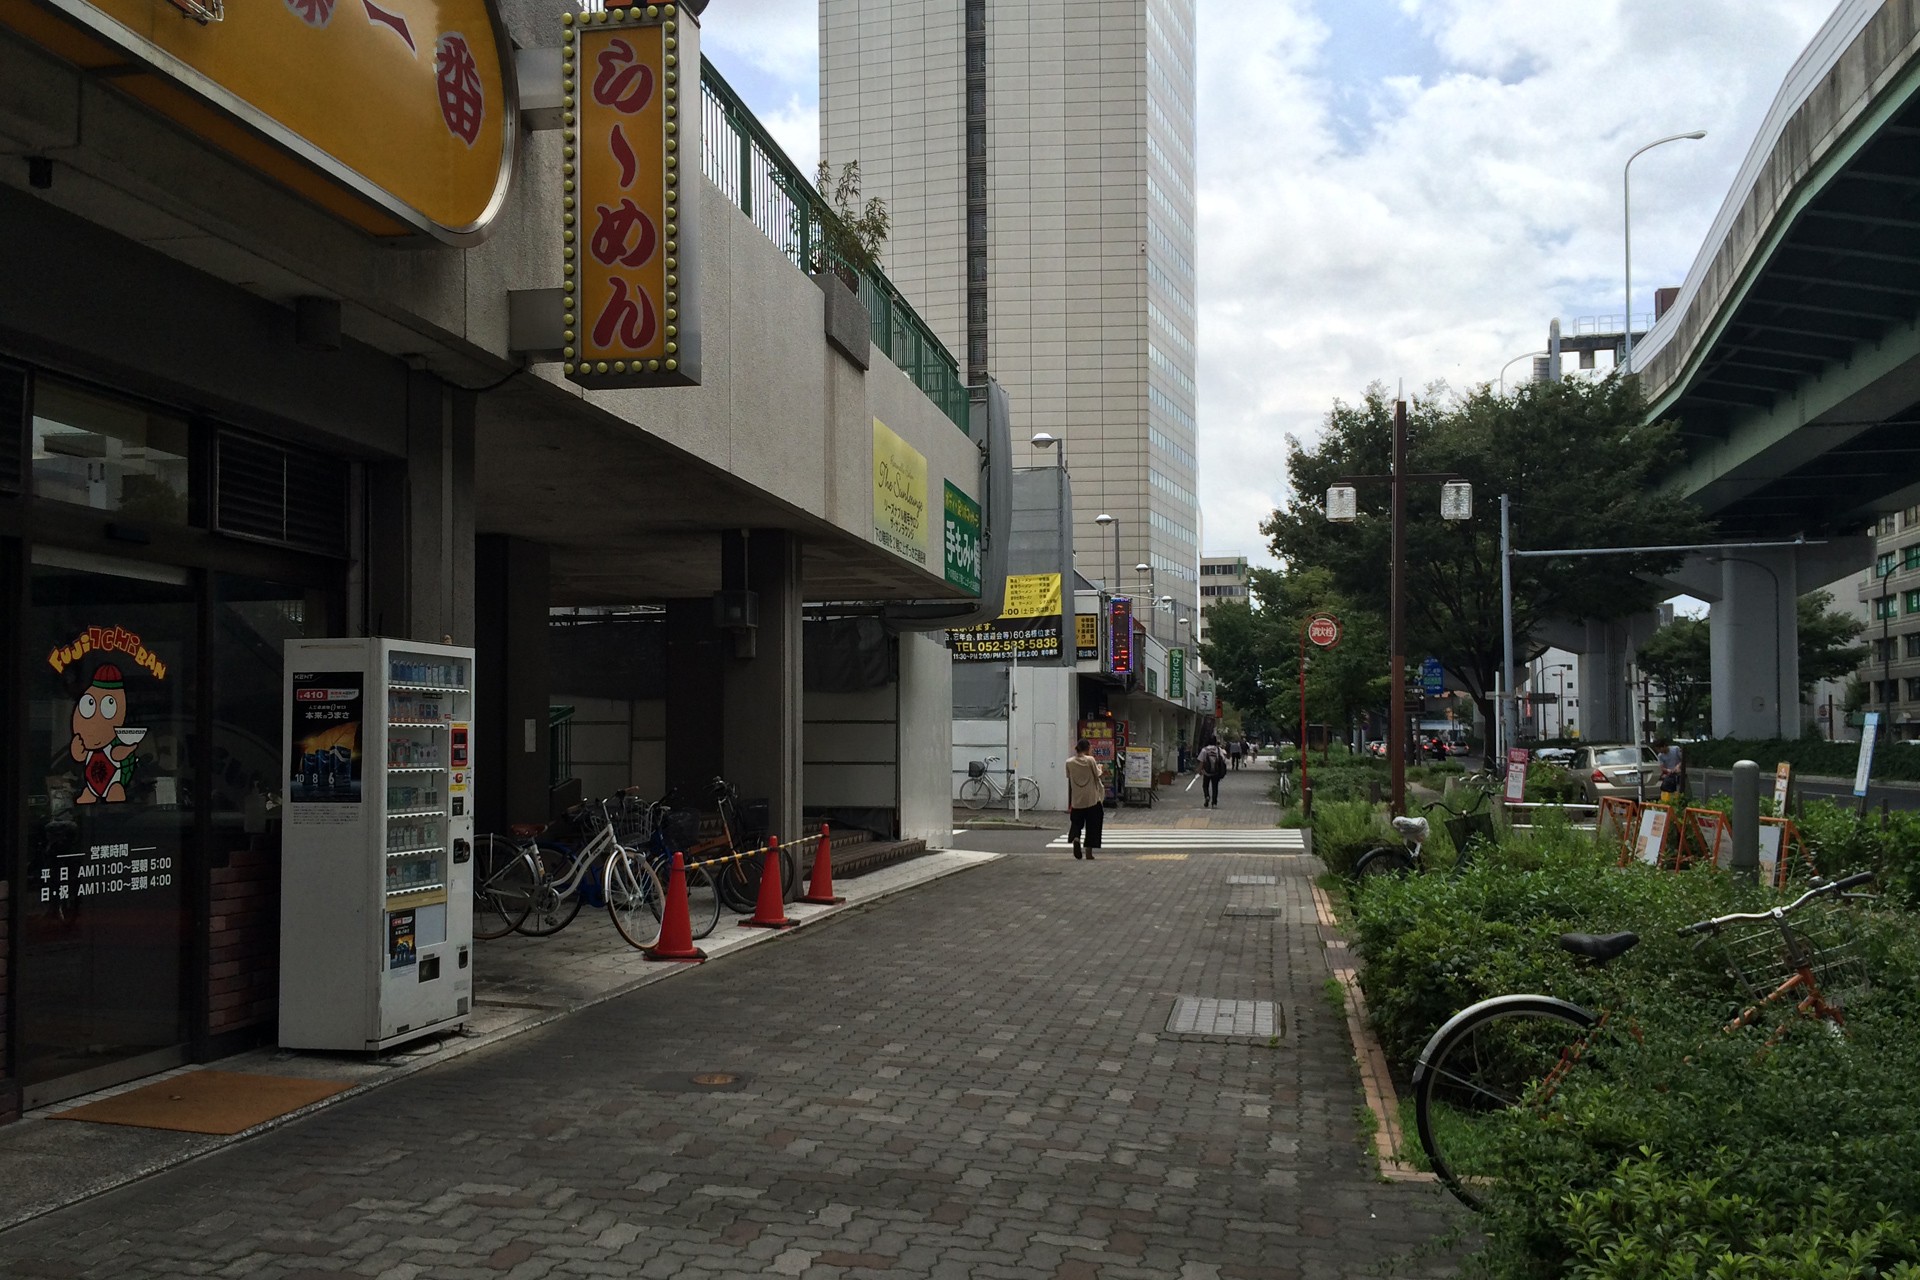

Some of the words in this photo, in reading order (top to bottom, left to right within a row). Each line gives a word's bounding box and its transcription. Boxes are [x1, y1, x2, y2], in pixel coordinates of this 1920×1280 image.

[1312, 627, 1334, 637] 消火栓
[956, 642, 977, 653] TEL
[295, 773, 305, 783] 10
[312, 773, 319, 784] 8
[328, 772, 335, 785] 6
[90, 843, 129, 860] 営業時間
